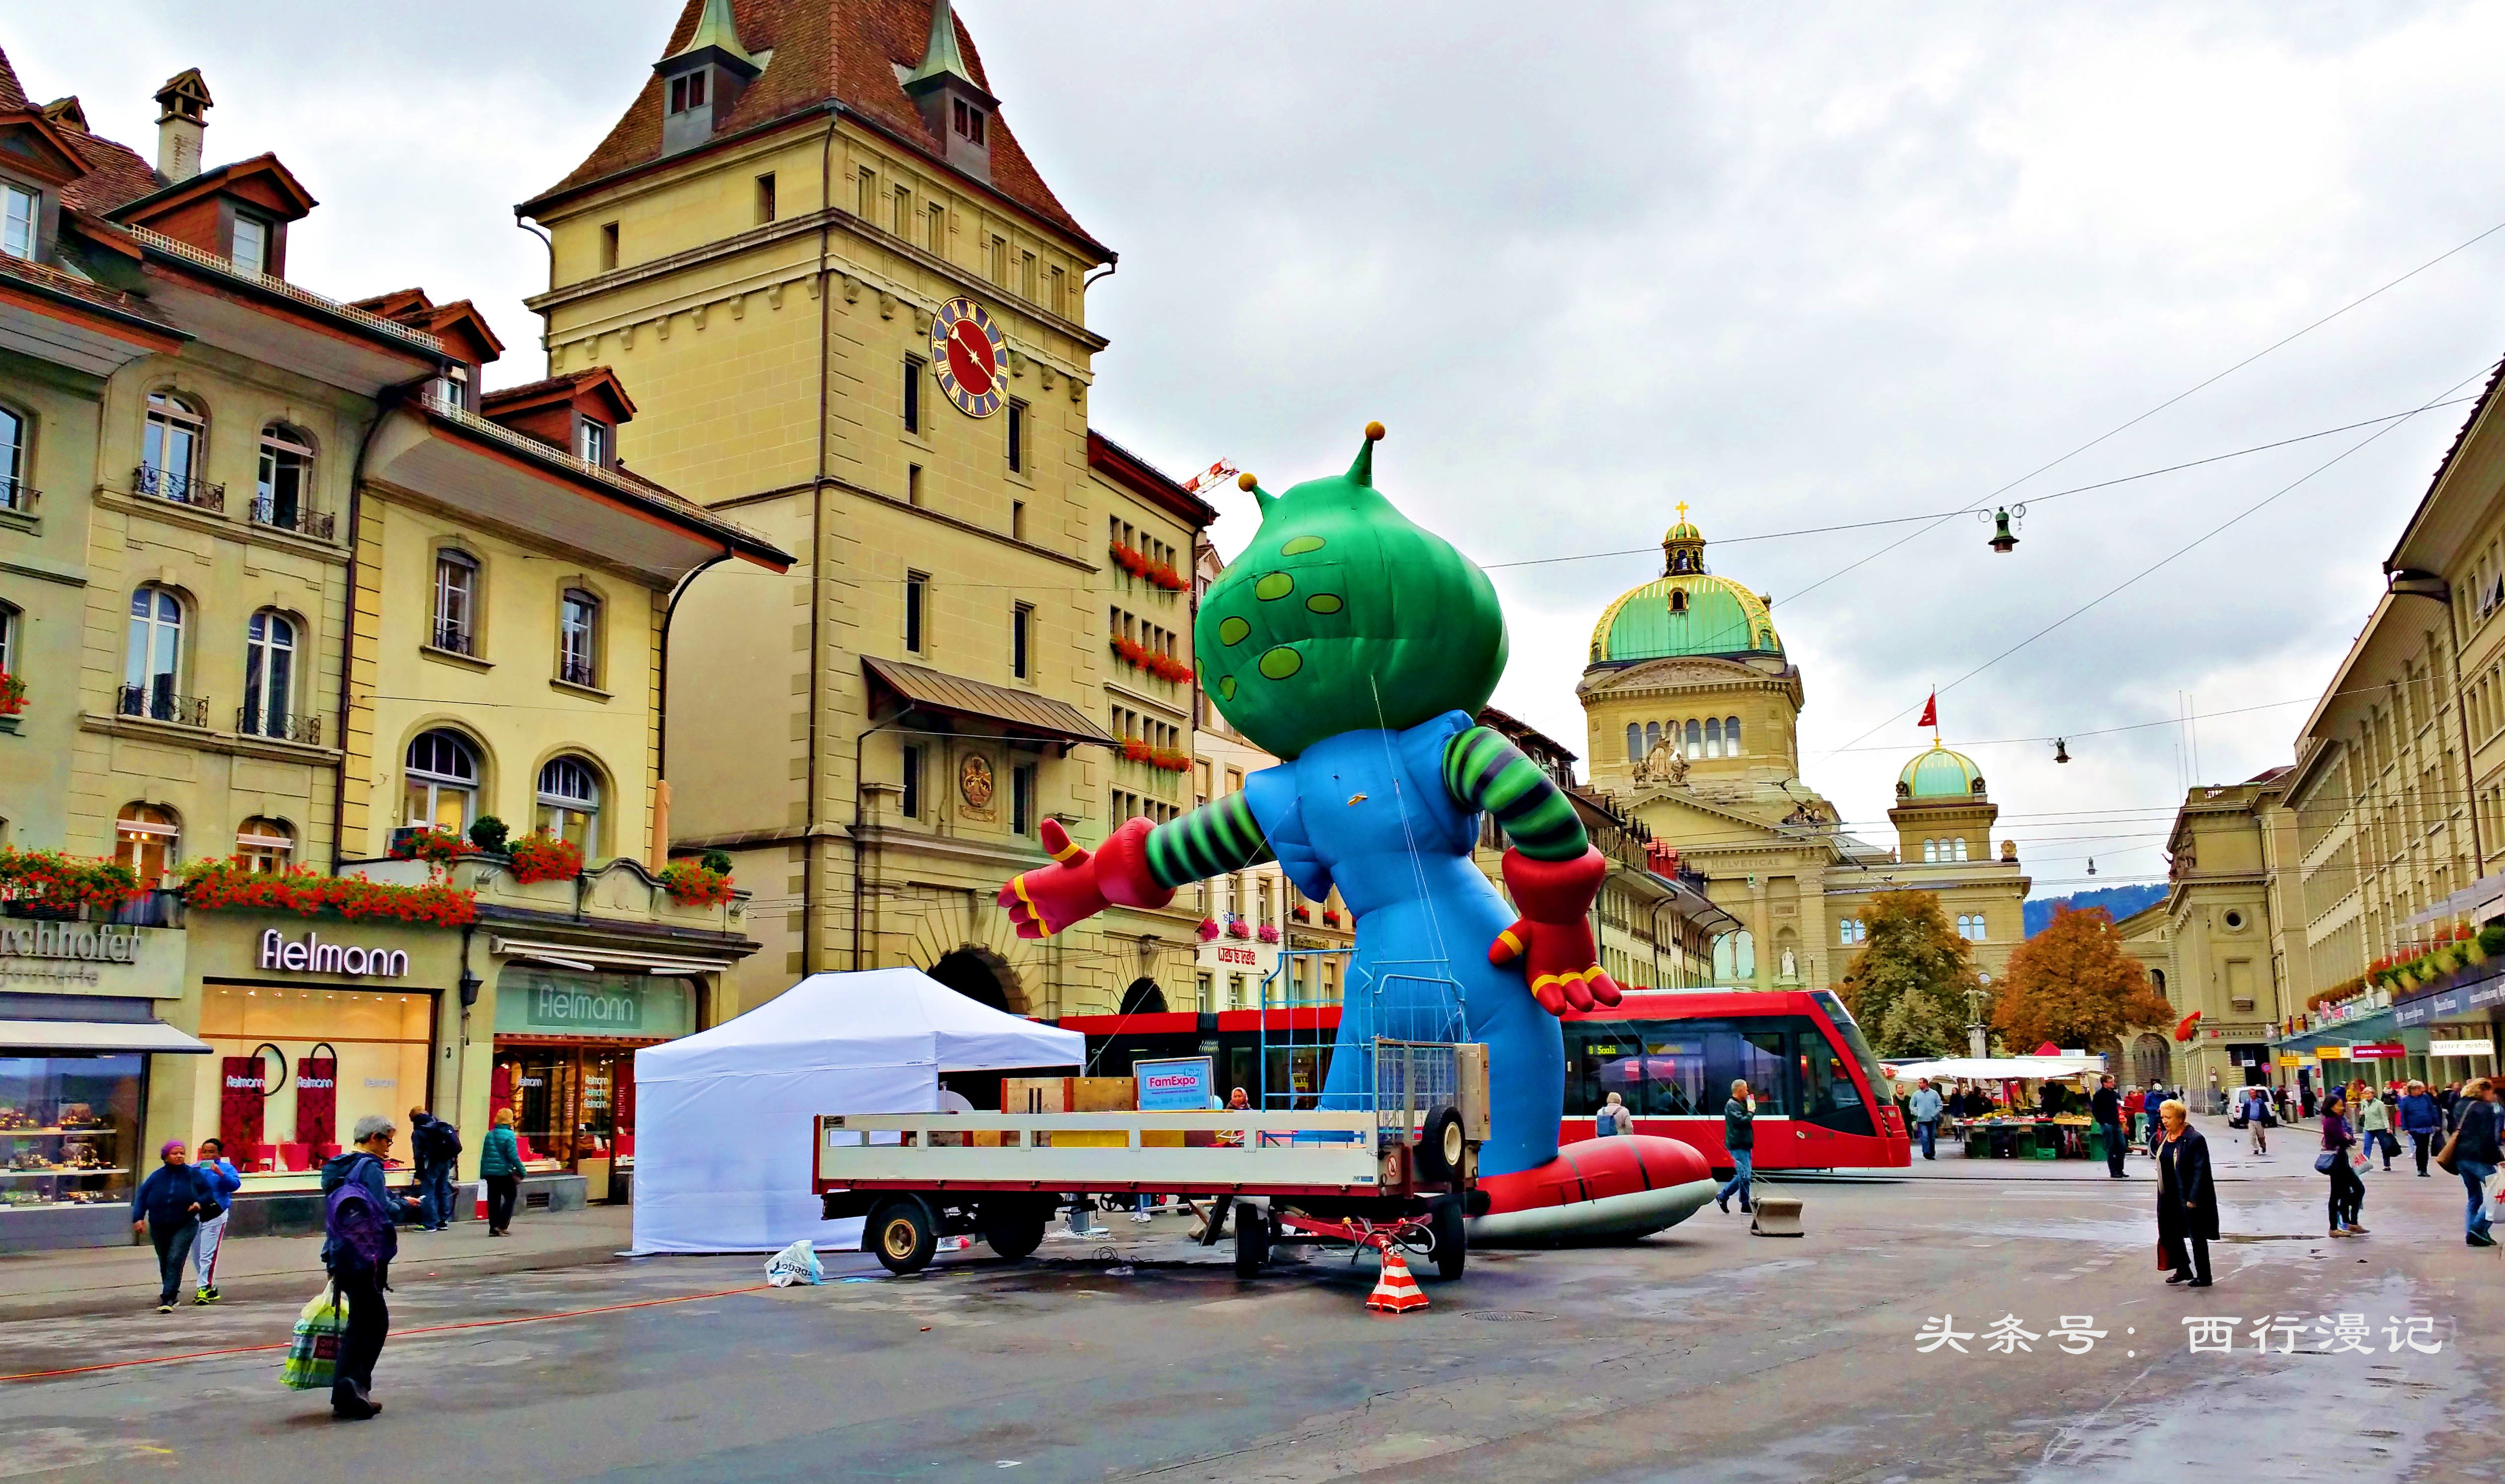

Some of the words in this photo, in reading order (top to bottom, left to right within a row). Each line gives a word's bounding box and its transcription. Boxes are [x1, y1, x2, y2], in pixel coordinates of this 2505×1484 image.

[1711, 859, 1780, 868] HELVETICAE
[262, 928, 408, 977] fielmann
[538, 984, 633, 1021] fielmann
[446, 1046, 451, 1058] 3
[1149, 1076, 1196, 1087] FamExpo
